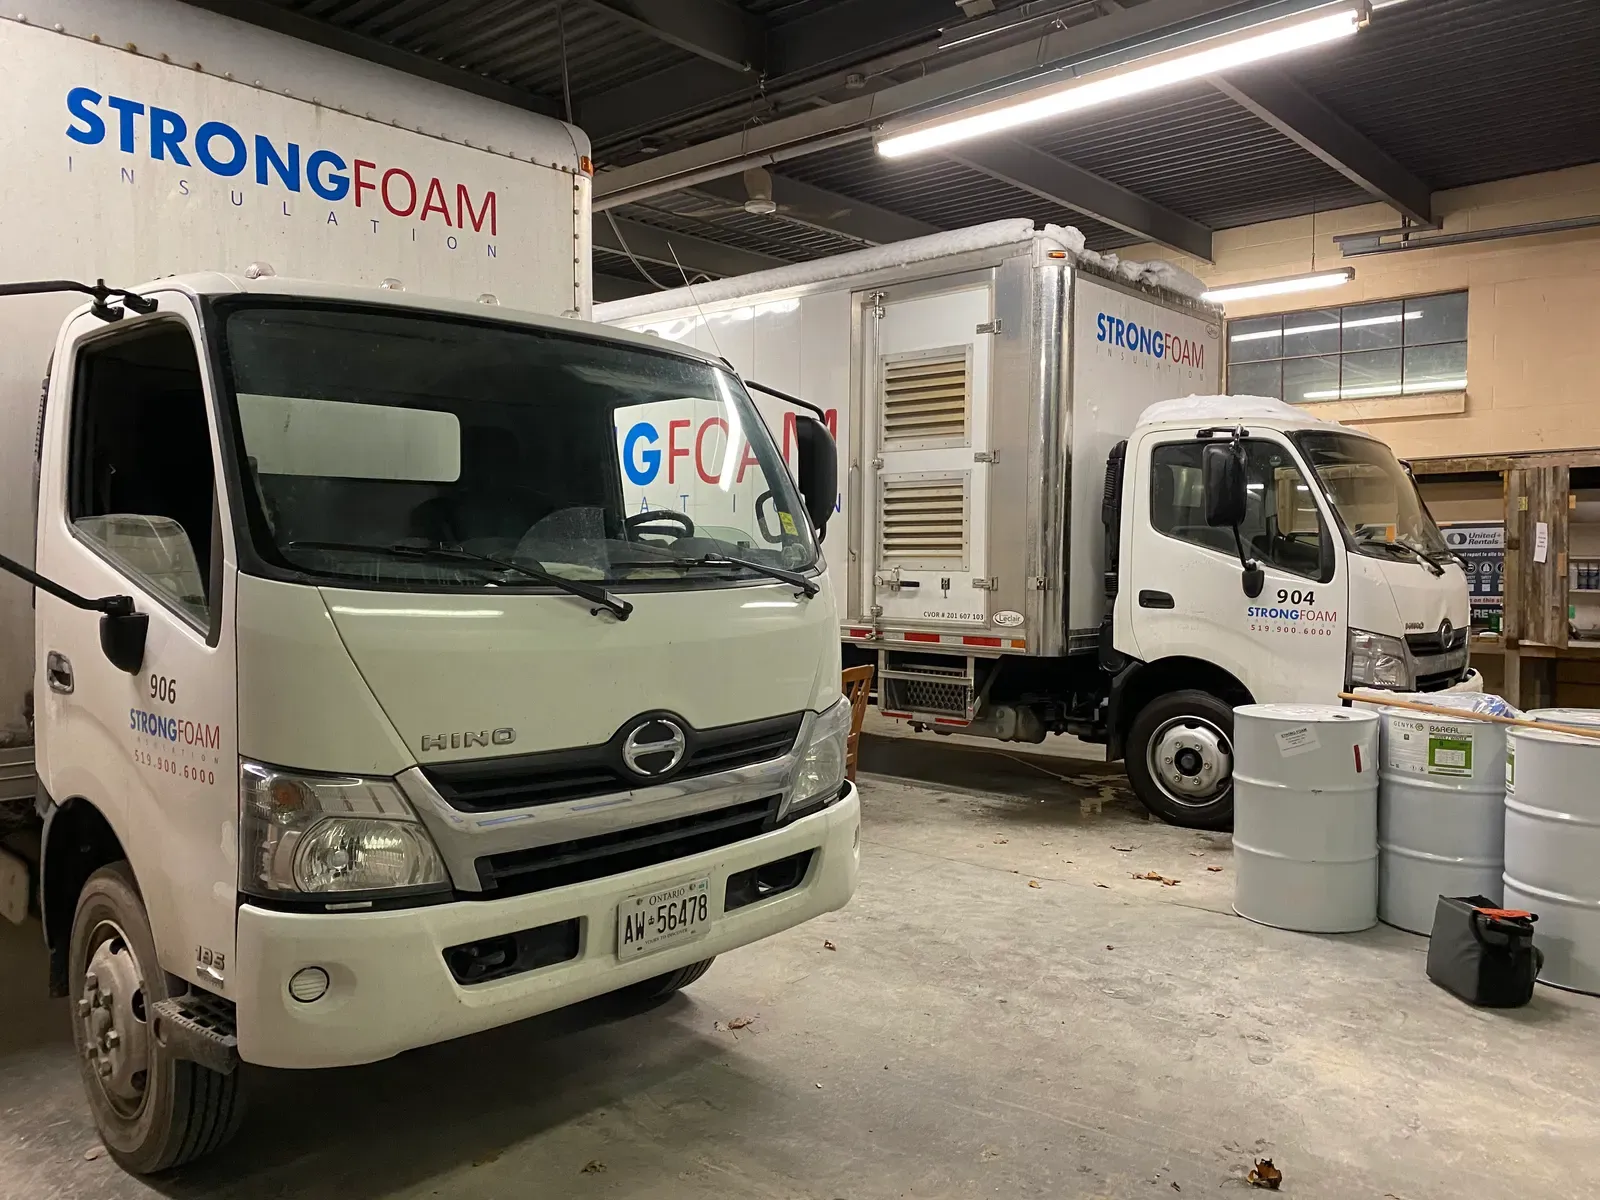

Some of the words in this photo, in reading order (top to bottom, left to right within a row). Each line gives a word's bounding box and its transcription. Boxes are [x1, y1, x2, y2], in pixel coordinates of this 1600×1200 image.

[65, 86, 497, 236] STRONGFOAM
[67, 155, 498, 258] INSULATION
[1096, 312, 1204, 369] STRONGFOAM
[1096, 345, 1204, 381] INSULATION
[1247, 606, 1337, 622] STRONGFOAM
[1276, 589, 1315, 606] 904
[1250, 624, 1332, 636] 519.900.6000
[1405, 621, 1424, 630] HINO
[150, 674, 177, 704] 906
[130, 708, 220, 750] STRONGFOAM
[421, 727, 517, 752] HINO
[134, 749, 215, 785] 519.900.6000
[649, 888, 685, 905] ONTARIO
[624, 910, 646, 944] AW
[657, 893, 708, 934] 56478
